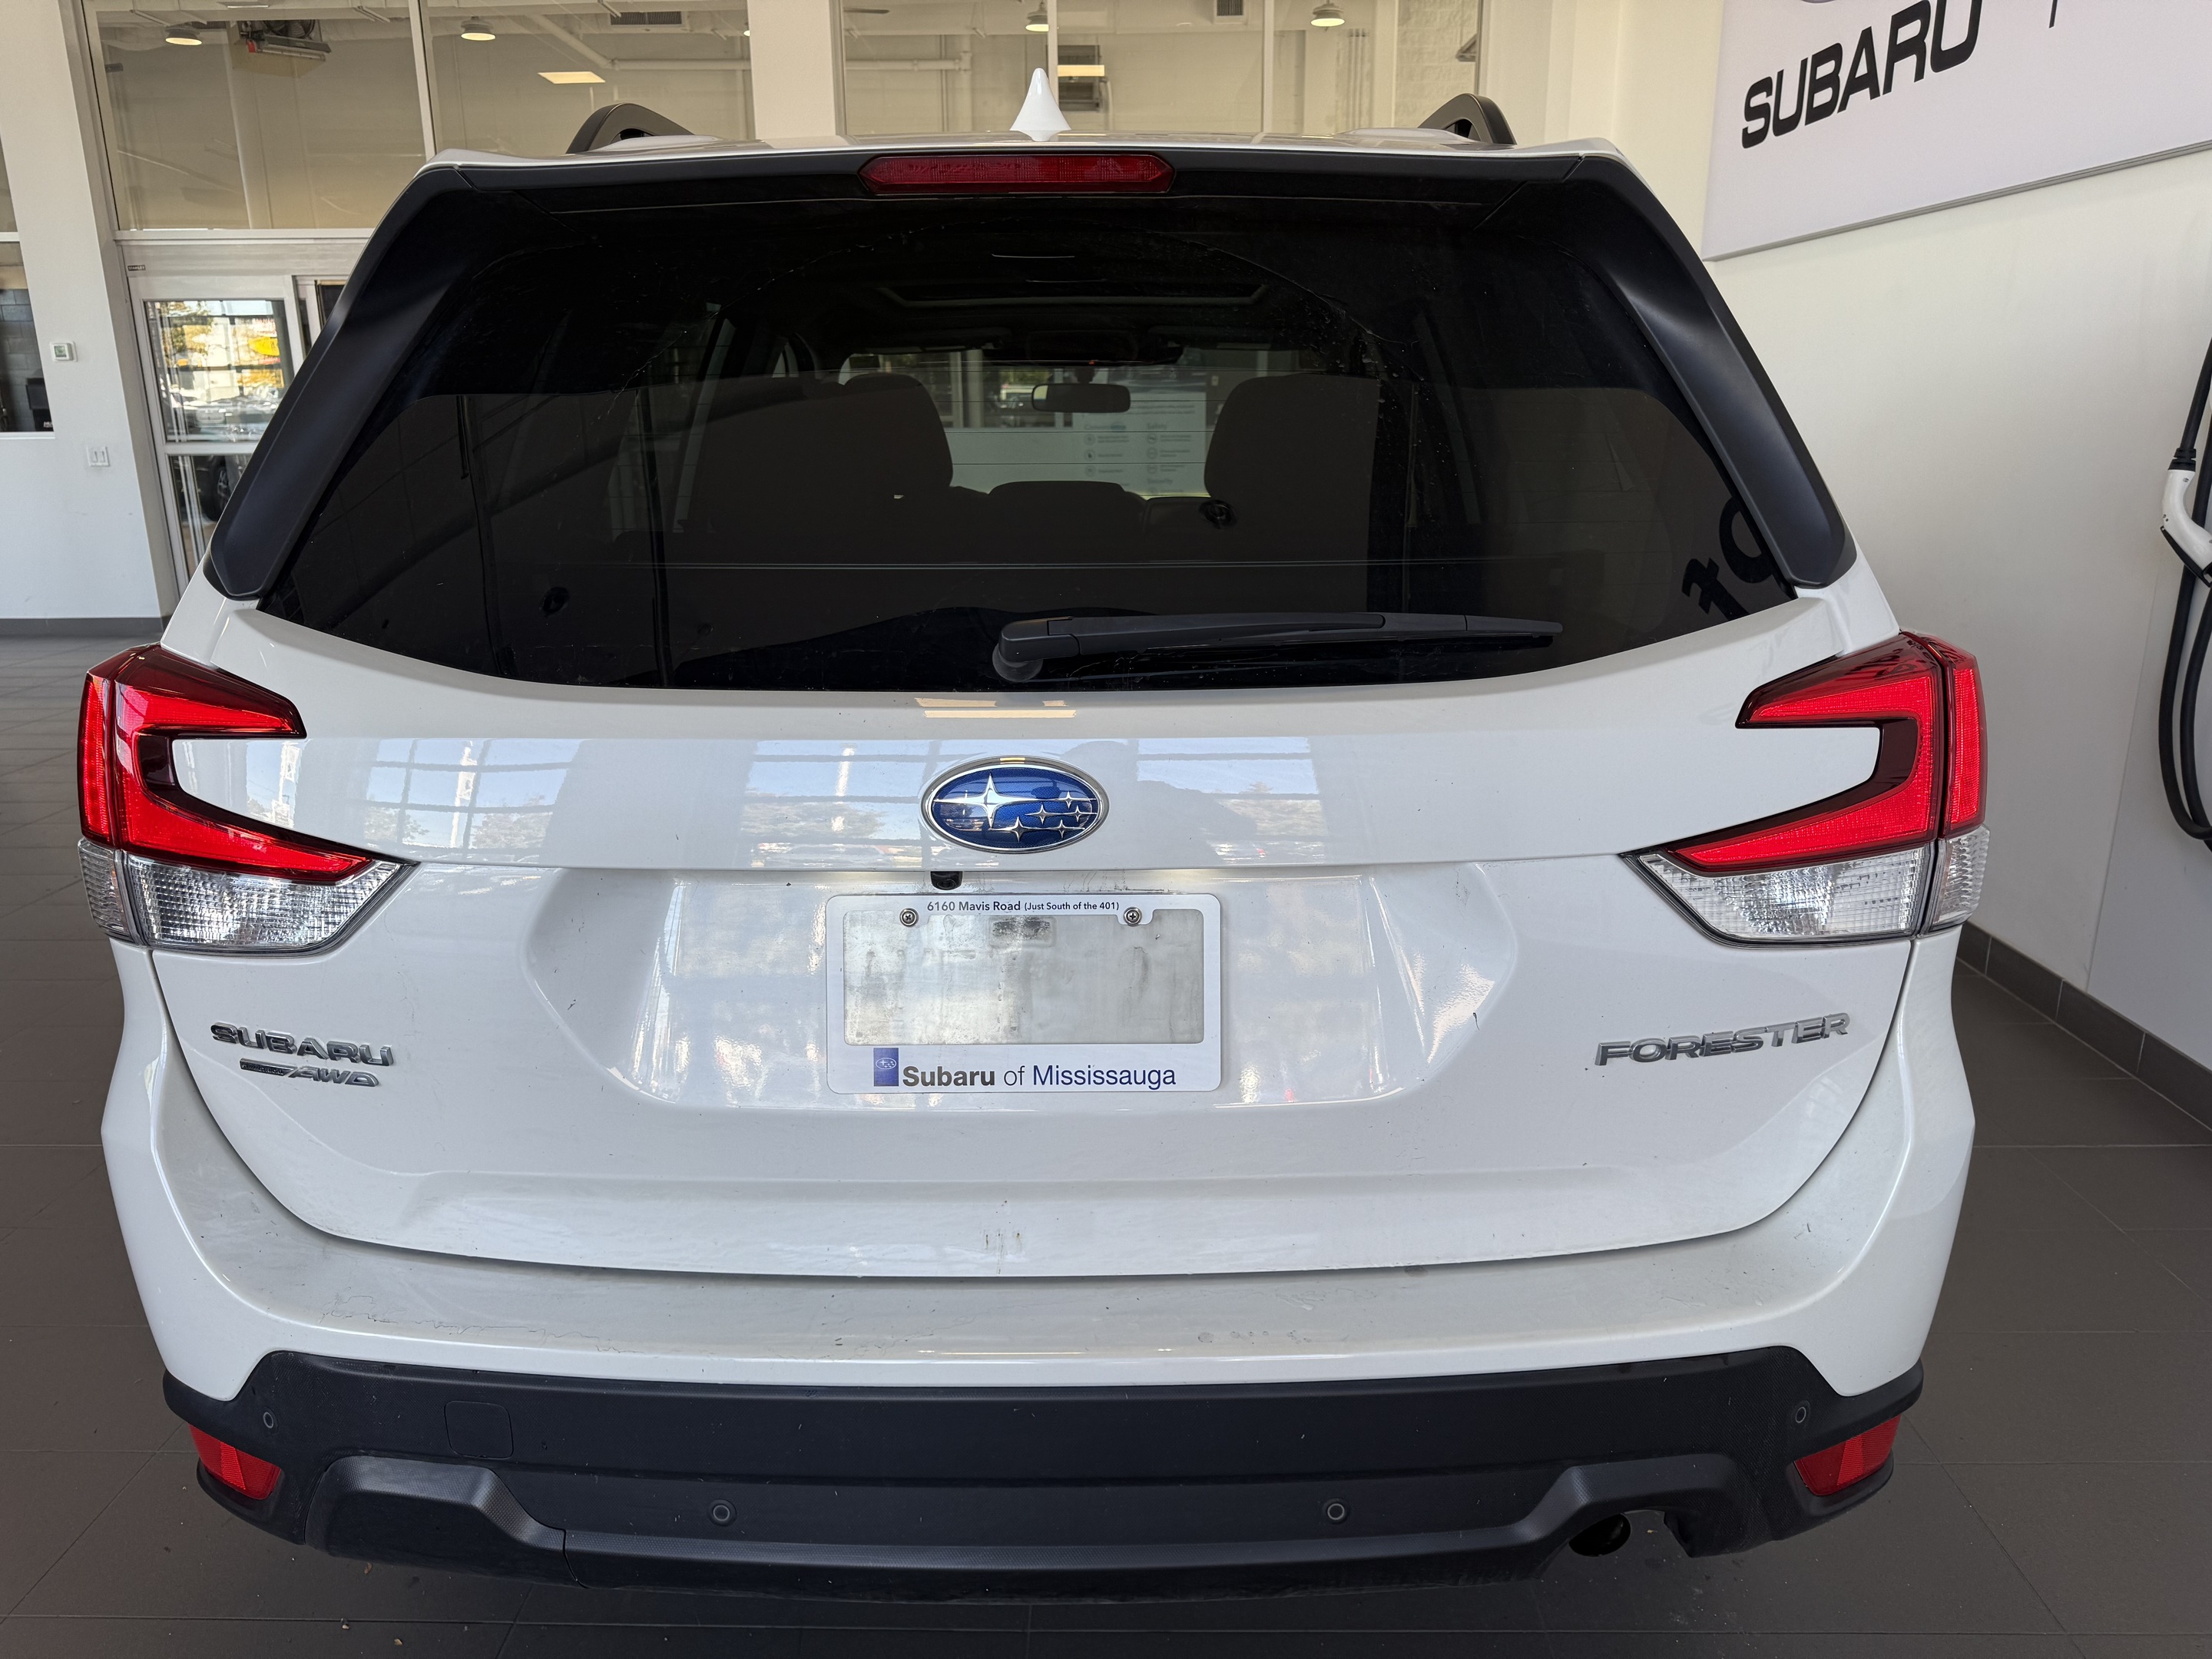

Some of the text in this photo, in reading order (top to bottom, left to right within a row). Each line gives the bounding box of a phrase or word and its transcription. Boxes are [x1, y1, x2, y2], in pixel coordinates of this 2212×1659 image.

[1741, 0, 1982, 149] SUBARU
[927, 900, 1119, 911] 6160 Mavis Road (Just South of the 401)
[210, 1022, 395, 1067] SUBARU
[1594, 1012, 1851, 1066] FORESTER
[288, 1065, 379, 1087] AWD
[902, 1065, 1177, 1091] Subaru of Mississauga
